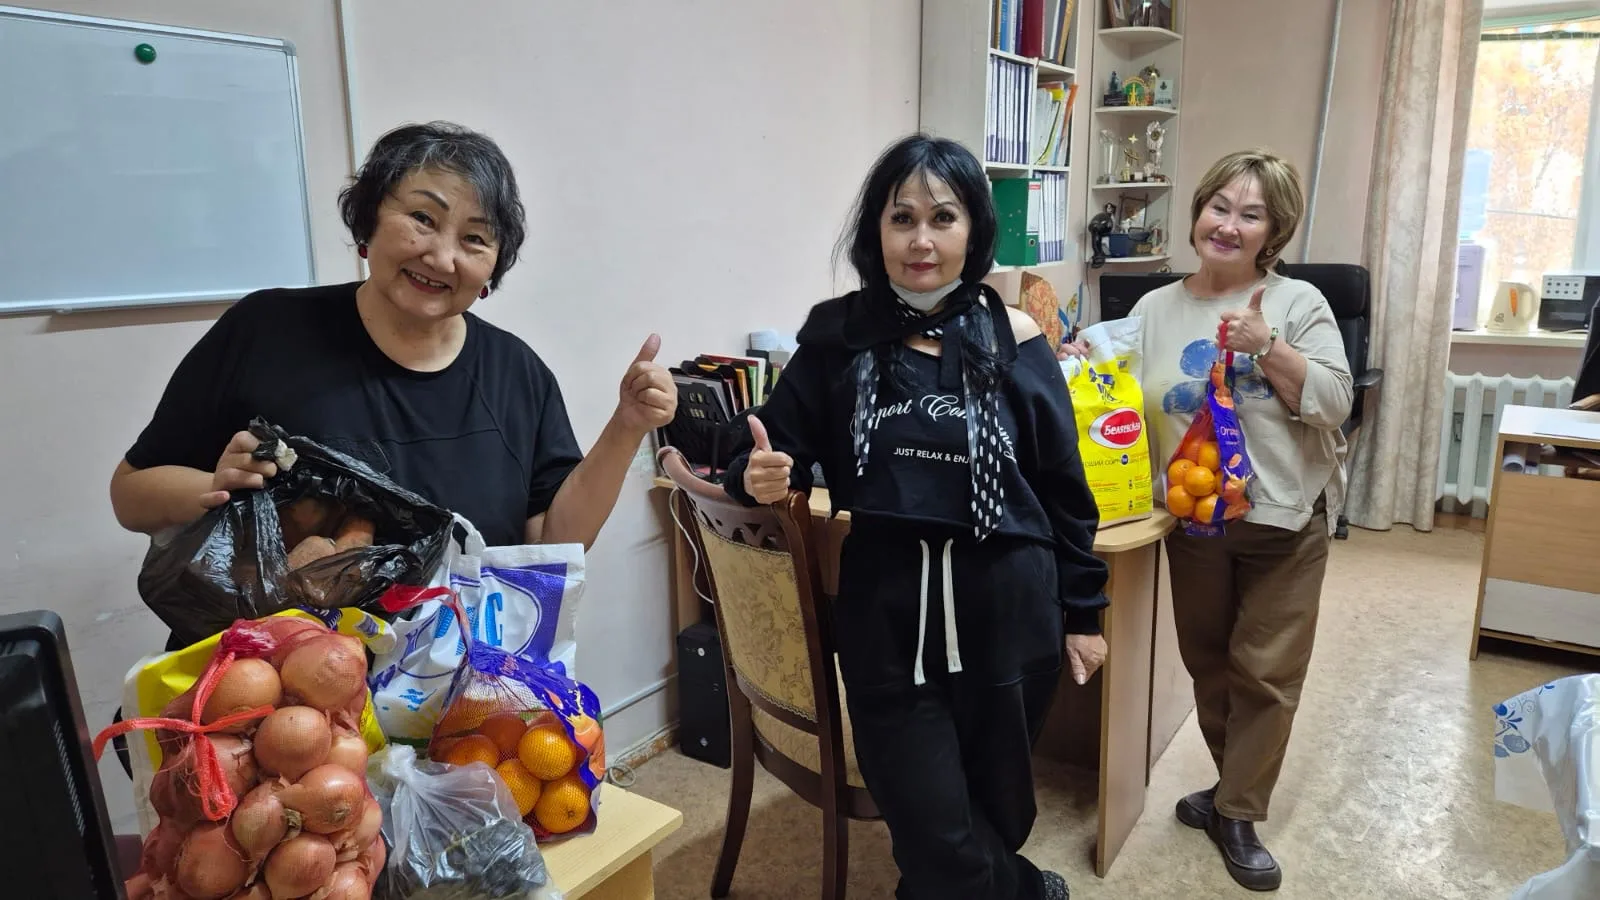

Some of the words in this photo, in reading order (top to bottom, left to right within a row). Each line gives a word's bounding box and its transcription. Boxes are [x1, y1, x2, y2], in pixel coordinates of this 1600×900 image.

[893, 447, 915, 457] JUST
[916, 449, 943, 461] RELAX
[944, 453, 951, 462] &
[953, 454, 970, 464] ENJ
